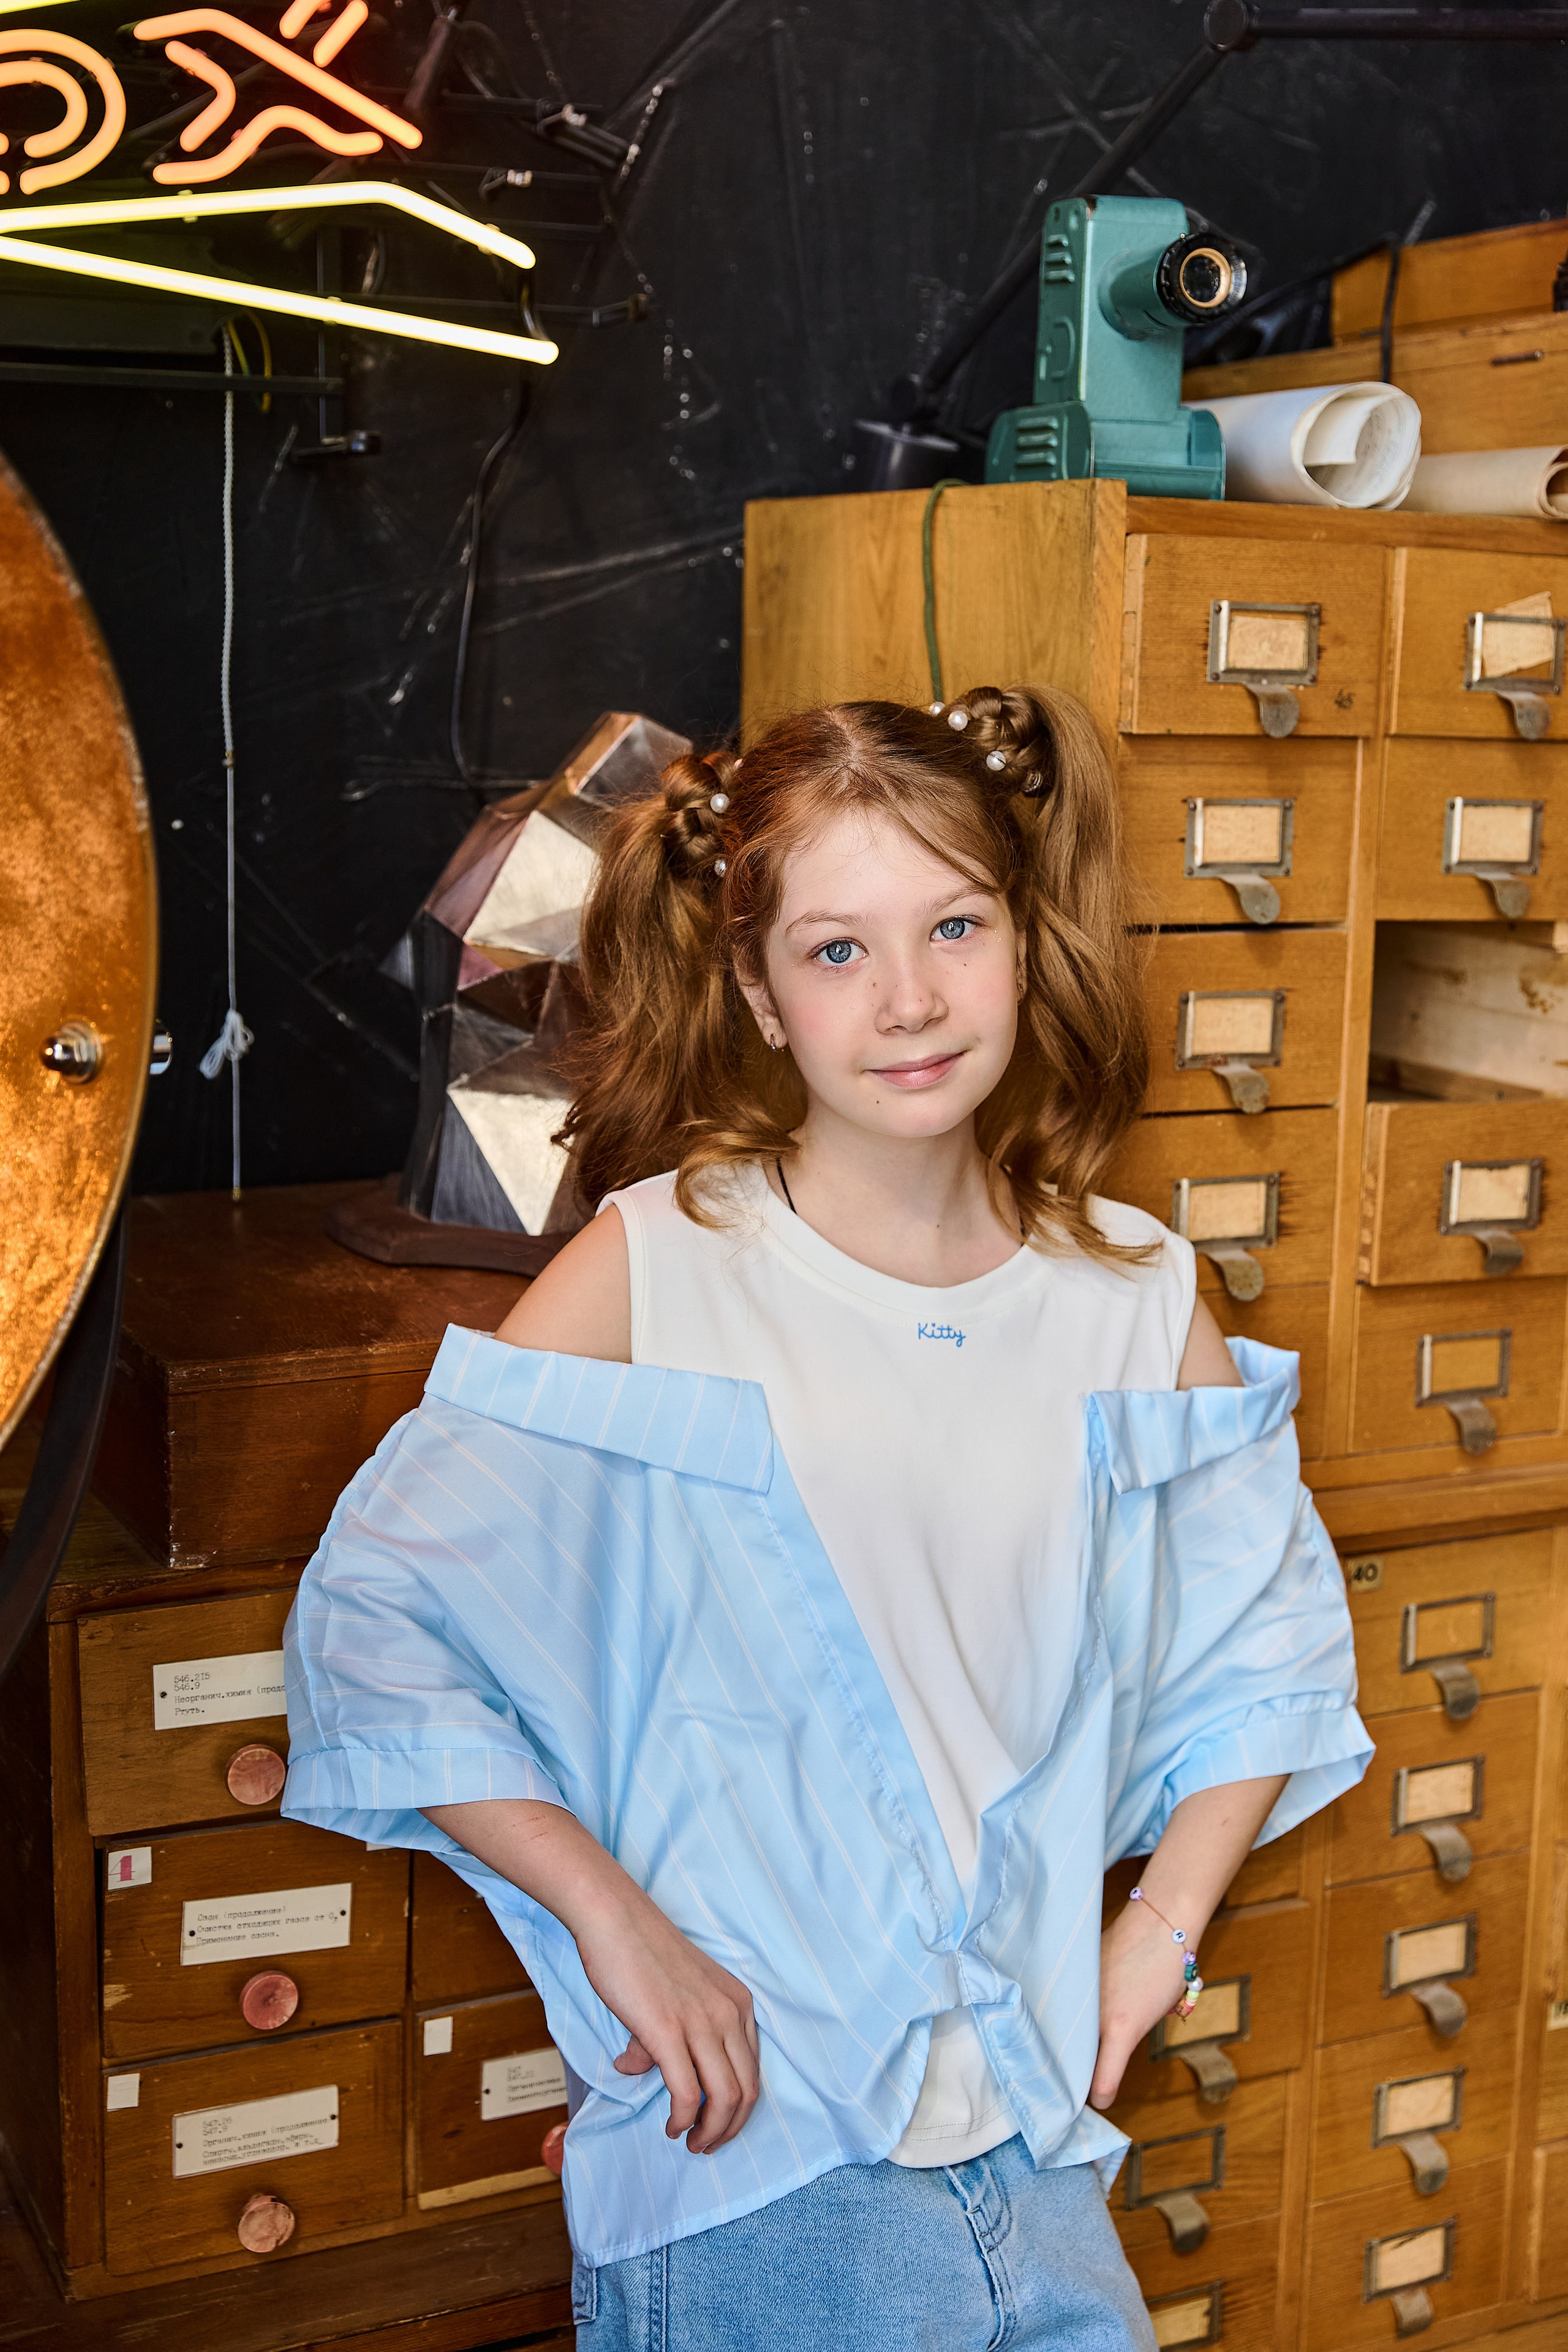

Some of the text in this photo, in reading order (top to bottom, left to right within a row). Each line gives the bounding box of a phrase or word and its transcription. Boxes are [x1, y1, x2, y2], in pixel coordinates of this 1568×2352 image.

[918, 1322, 966, 1348] Kitty
[175, 1682, 200, 1691] 546.9
[108, 1855, 136, 1883] 4
[196, 1935, 246, 1947] Применение
